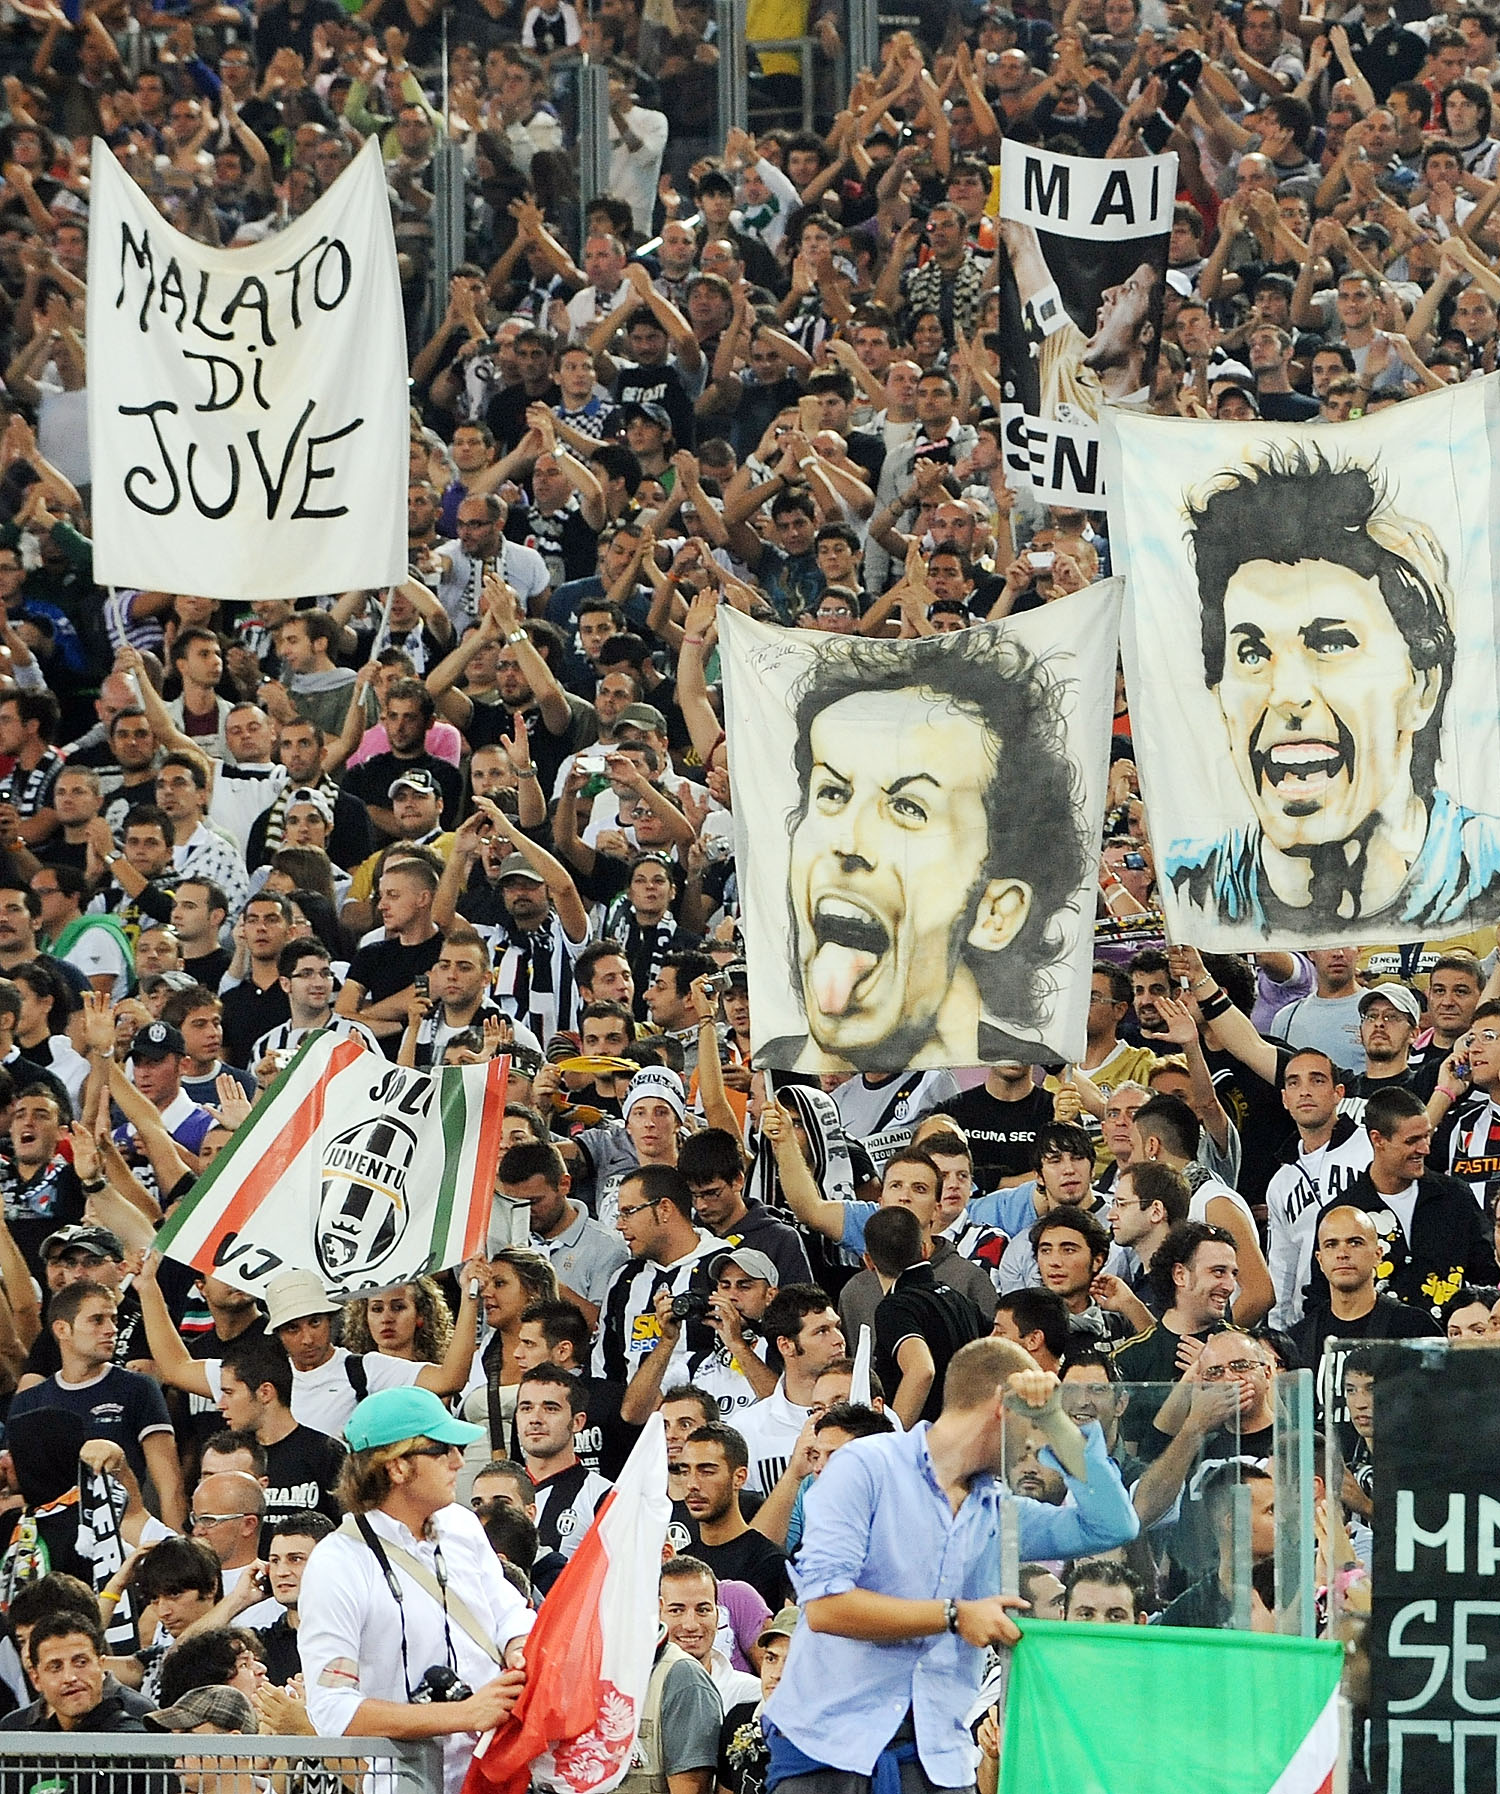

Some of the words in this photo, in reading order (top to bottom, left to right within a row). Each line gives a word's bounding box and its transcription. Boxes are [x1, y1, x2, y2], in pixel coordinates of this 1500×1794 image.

[1024, 156, 1160, 225] MAI
[116, 221, 352, 345] MALATO
[118, 400, 364, 520] JUVE
[1006, 416, 1106, 495] SEN
[867, 1131, 912, 1148] HOLLAND
[963, 1129, 1007, 1143] AGUNA
[1009, 1131, 1037, 1143] SEC
[325, 1147, 407, 1190] JUVENTU
[871, 1149, 896, 1162] ROUP
[632, 1315, 663, 1341] SK
[631, 1339, 660, 1352] SPO
